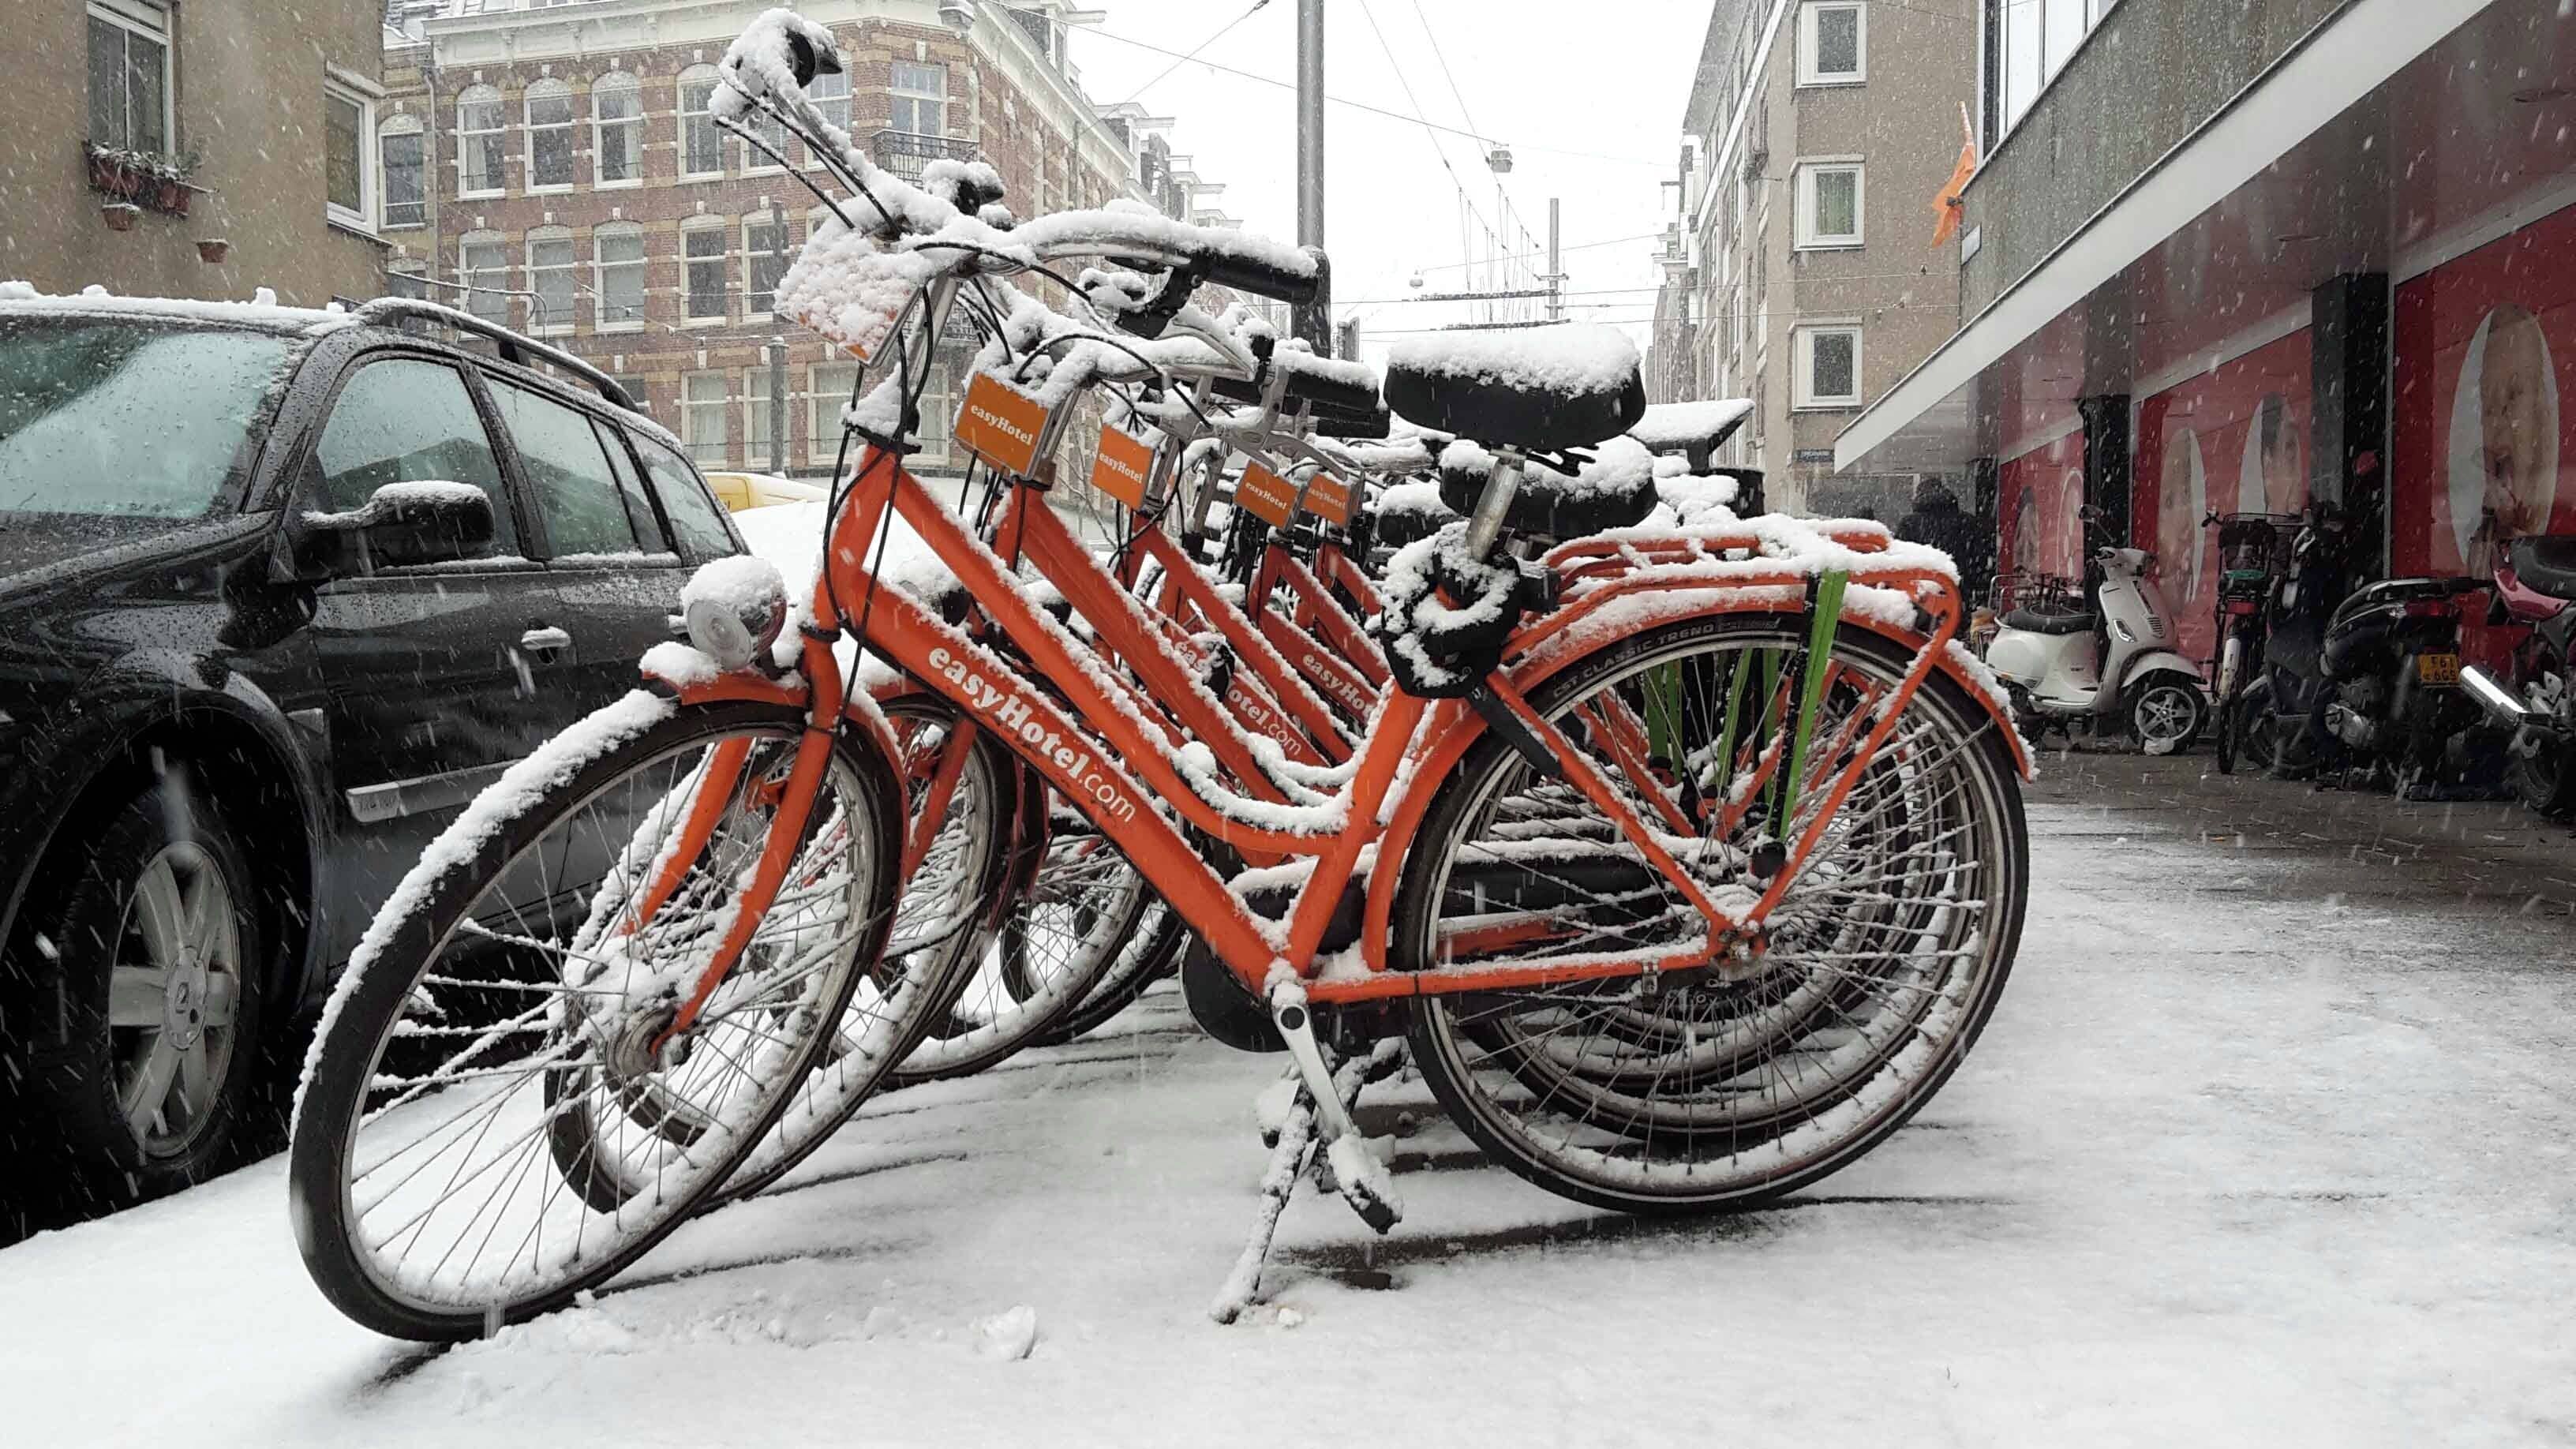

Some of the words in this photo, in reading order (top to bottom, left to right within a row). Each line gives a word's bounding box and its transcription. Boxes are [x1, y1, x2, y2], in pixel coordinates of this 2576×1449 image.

[970, 403, 1034, 446] easyHotel
[1098, 451, 1144, 485] easyHotel
[1245, 481, 1288, 511] easyHotel
[1583, 639, 1653, 677] CLASSIC
[1657, 623, 1714, 646] TREND
[928, 647, 1136, 822] easyHotel.com
